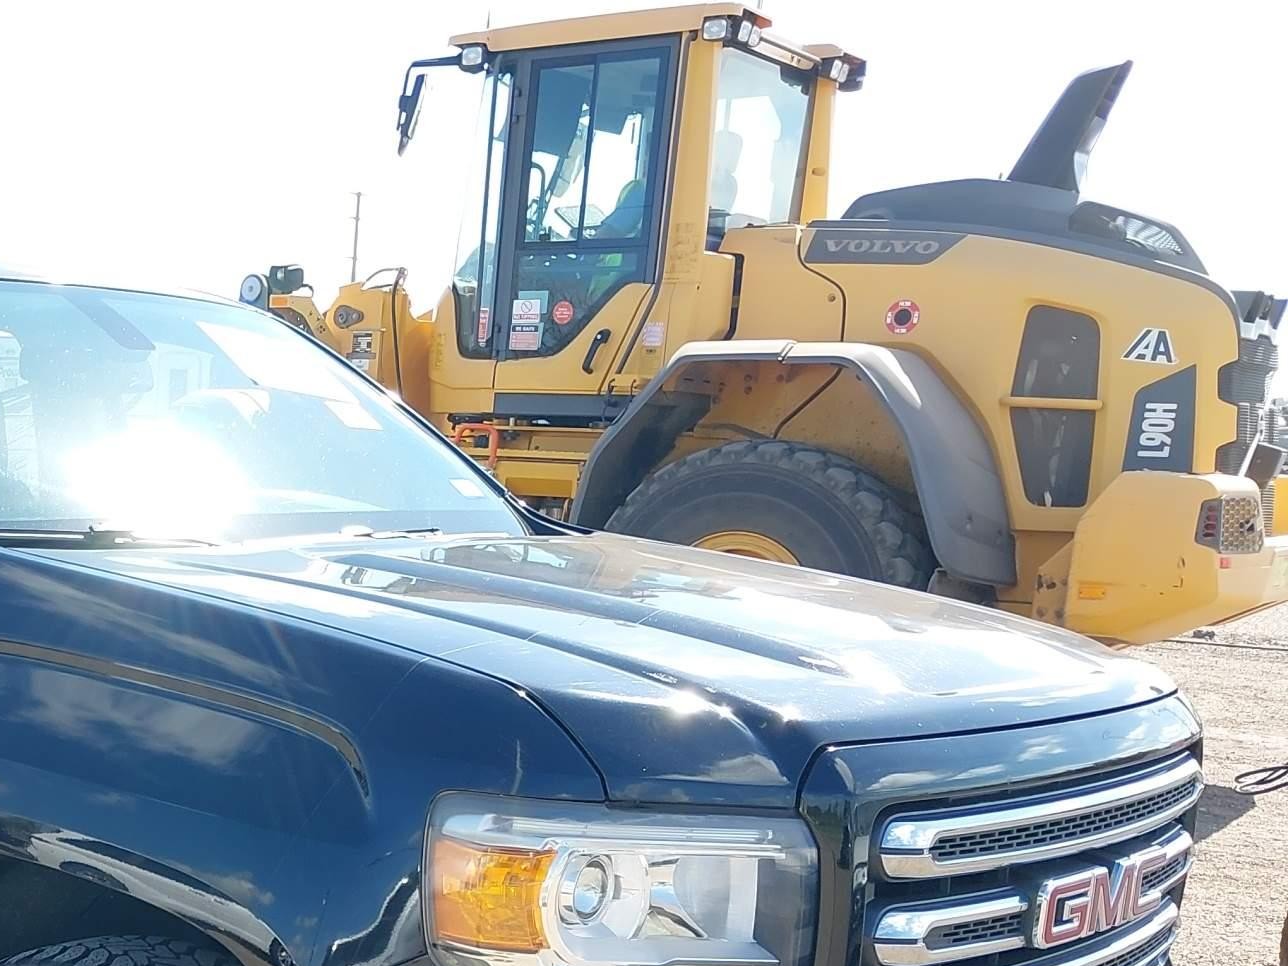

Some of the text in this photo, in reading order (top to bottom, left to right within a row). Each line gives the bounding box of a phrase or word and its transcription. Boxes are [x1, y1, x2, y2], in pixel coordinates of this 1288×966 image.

[824, 239, 940, 254] VOLVO
[1137, 402, 1179, 458] L90H
[1033, 846, 1168, 949] GMC
